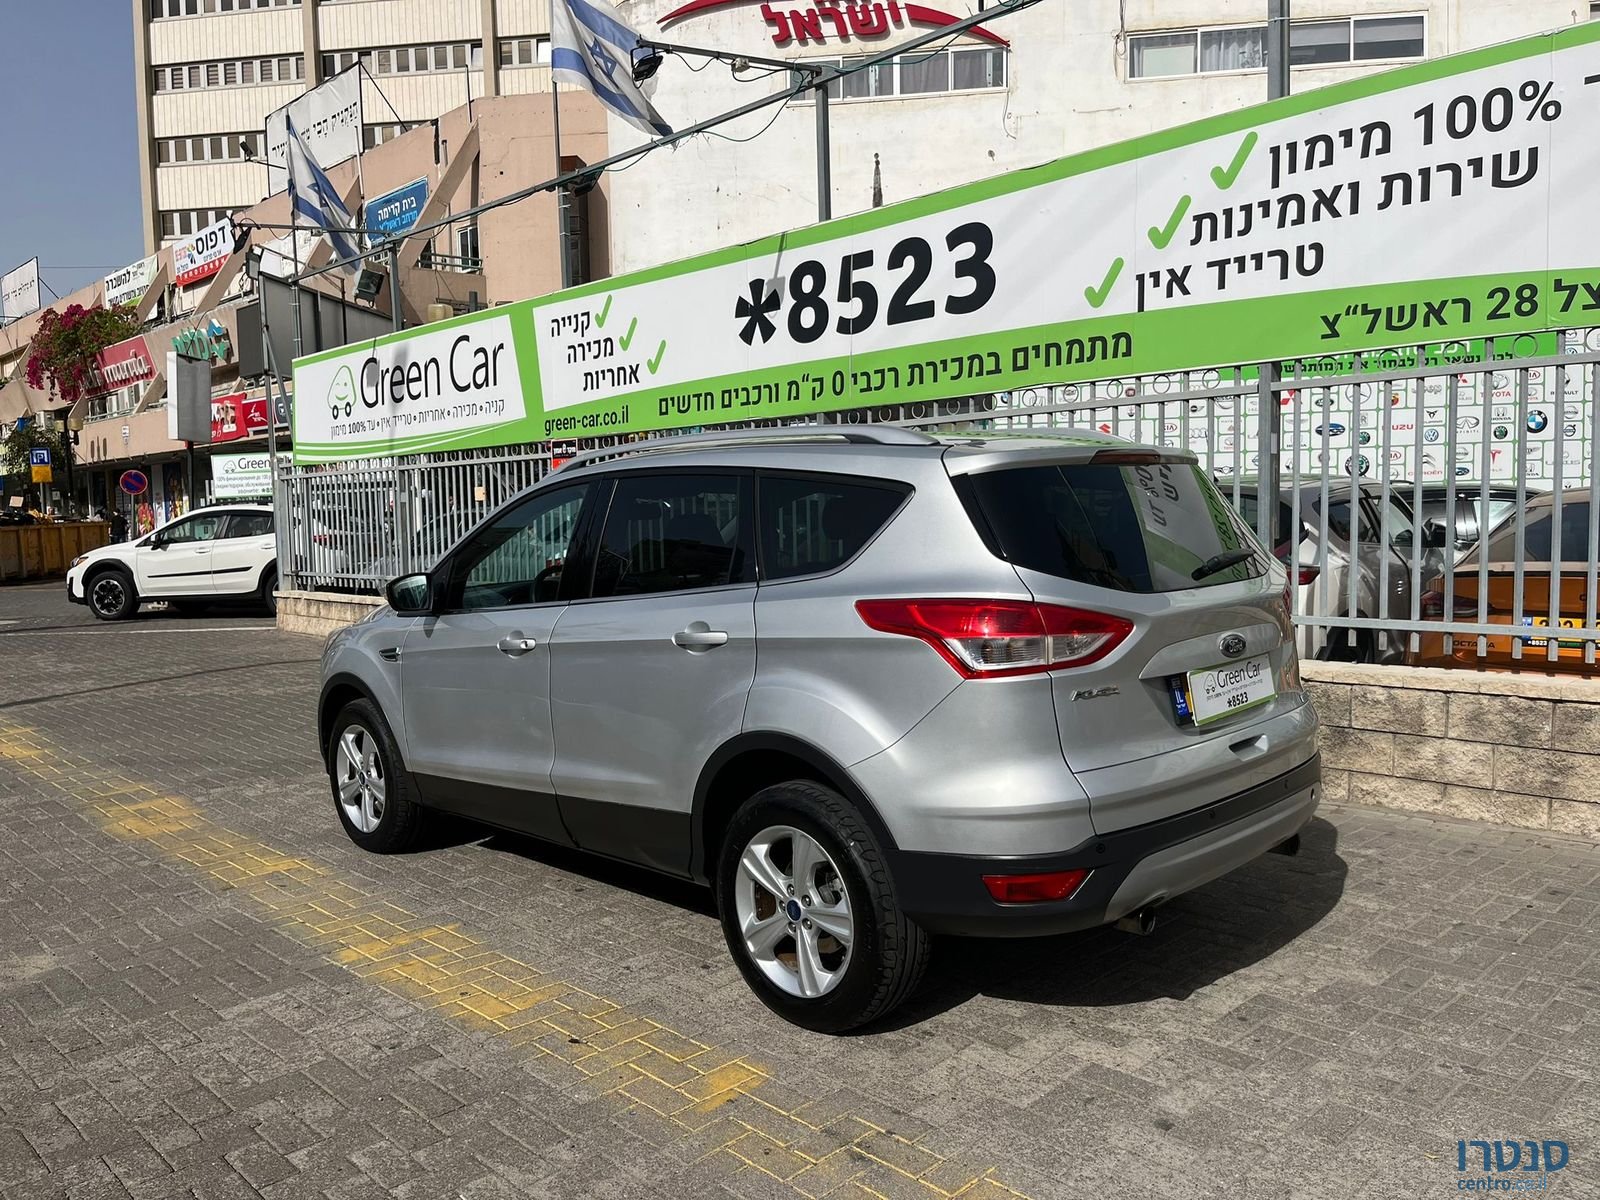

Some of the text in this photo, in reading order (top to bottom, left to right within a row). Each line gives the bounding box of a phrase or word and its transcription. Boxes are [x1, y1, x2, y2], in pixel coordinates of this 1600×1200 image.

[761, 1, 901, 42] ישראל
[1269, 80, 1562, 189] 100% מימון
[402, 196, 416, 211] בית
[1190, 146, 1538, 246] שירות ואמינות
[195, 225, 226, 255] דפוס
[1135, 242, 1324, 313] טרייד אין
[1487, 283, 1539, 321] 28
[551, 311, 591, 338] קנייה
[1320, 297, 1471, 340] ראשל"צ
[567, 337, 615, 364] מכירה
[1011, 332, 1132, 372] מתמחים
[360, 335, 505, 410] Green Car
[583, 364, 641, 391] אחריות
[851, 366, 900, 393] רכבי
[907, 351, 1002, 387] במכירת
[720, 382, 780, 410] ורכבים
[831, 370, 845, 396] 0
[419, 407, 446, 424] אחריות
[452, 403, 478, 420] מכירה
[485, 399, 506, 417] קניה
[659, 391, 715, 417] חדשים
[348, 421, 367, 435] 100%
[392, 412, 412, 427] טרייד
[544, 405, 630, 437] green-car.co.il
[238, 457, 271, 470] Green
[1217, 668, 1246, 688] Green
[1245, 661, 1261, 679] Car
